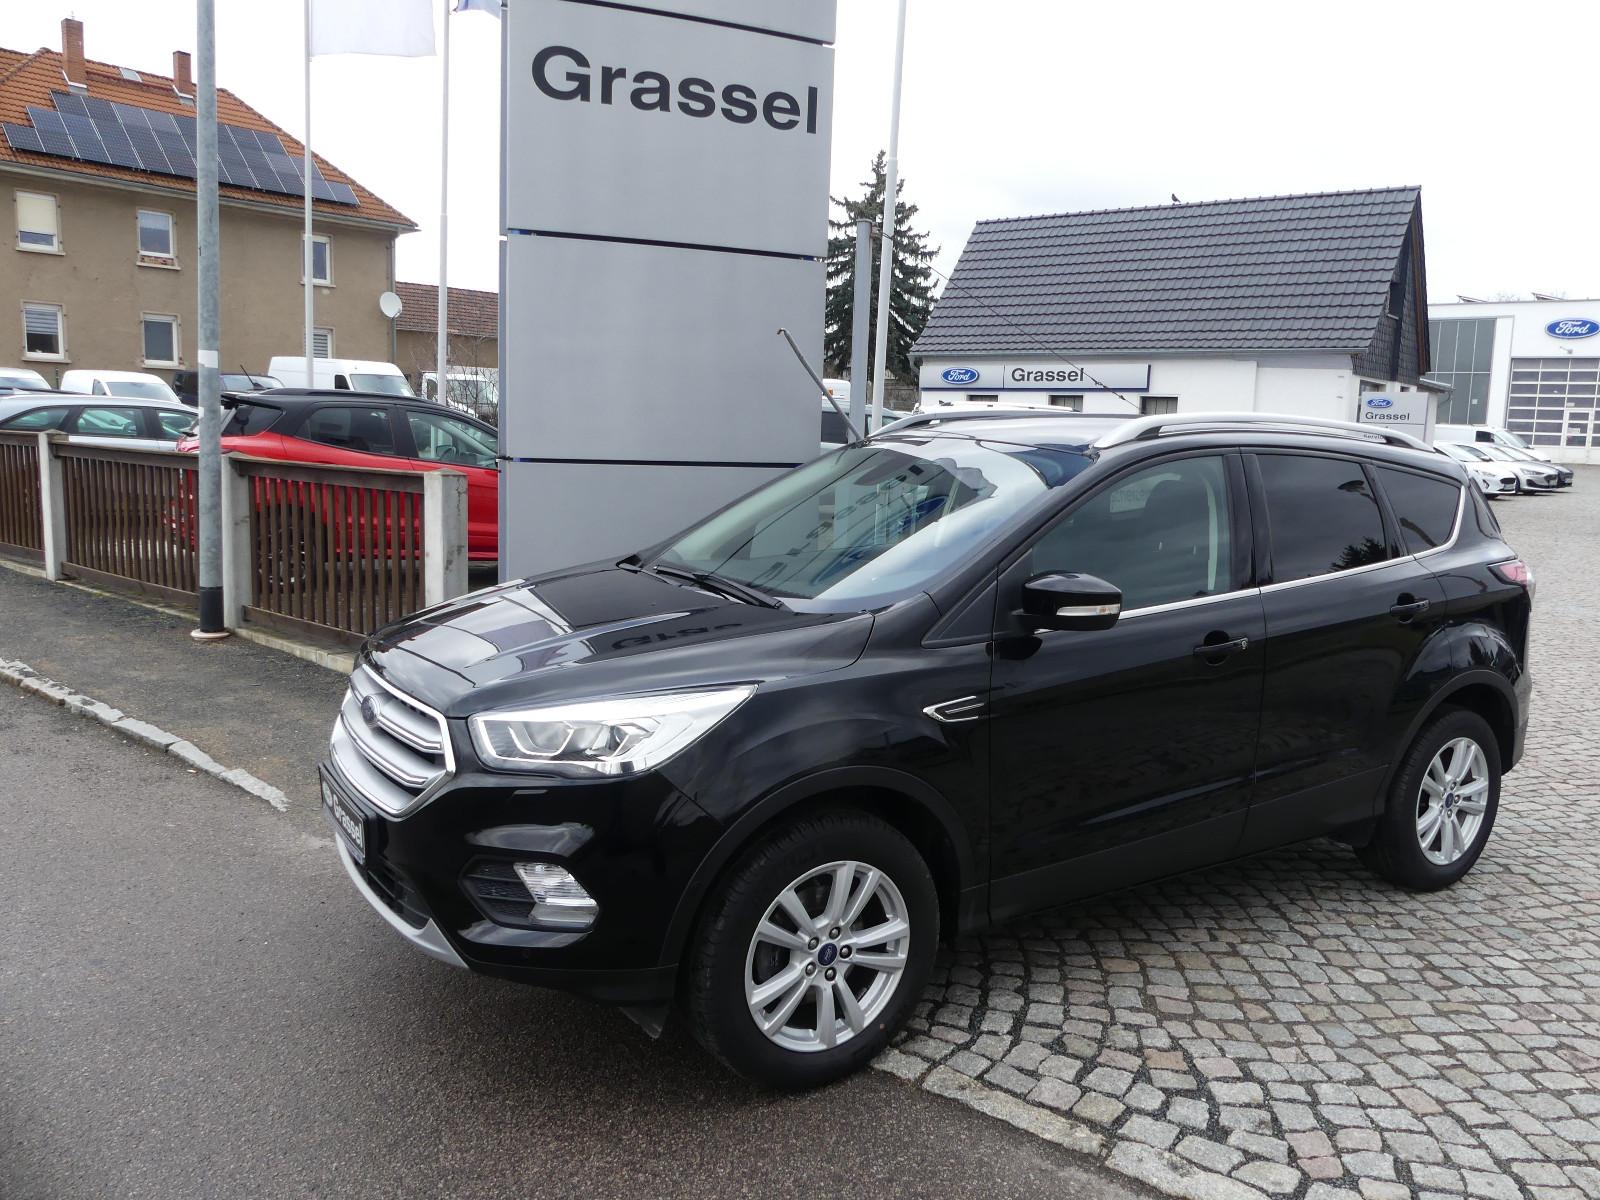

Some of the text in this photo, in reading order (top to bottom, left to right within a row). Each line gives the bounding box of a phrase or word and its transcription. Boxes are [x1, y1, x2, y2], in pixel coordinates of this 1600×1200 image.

[531, 45, 818, 135] Grassel
[1011, 367, 1084, 382] Grassel
[1365, 411, 1410, 421] Grassel
[333, 793, 363, 848] Grassel
